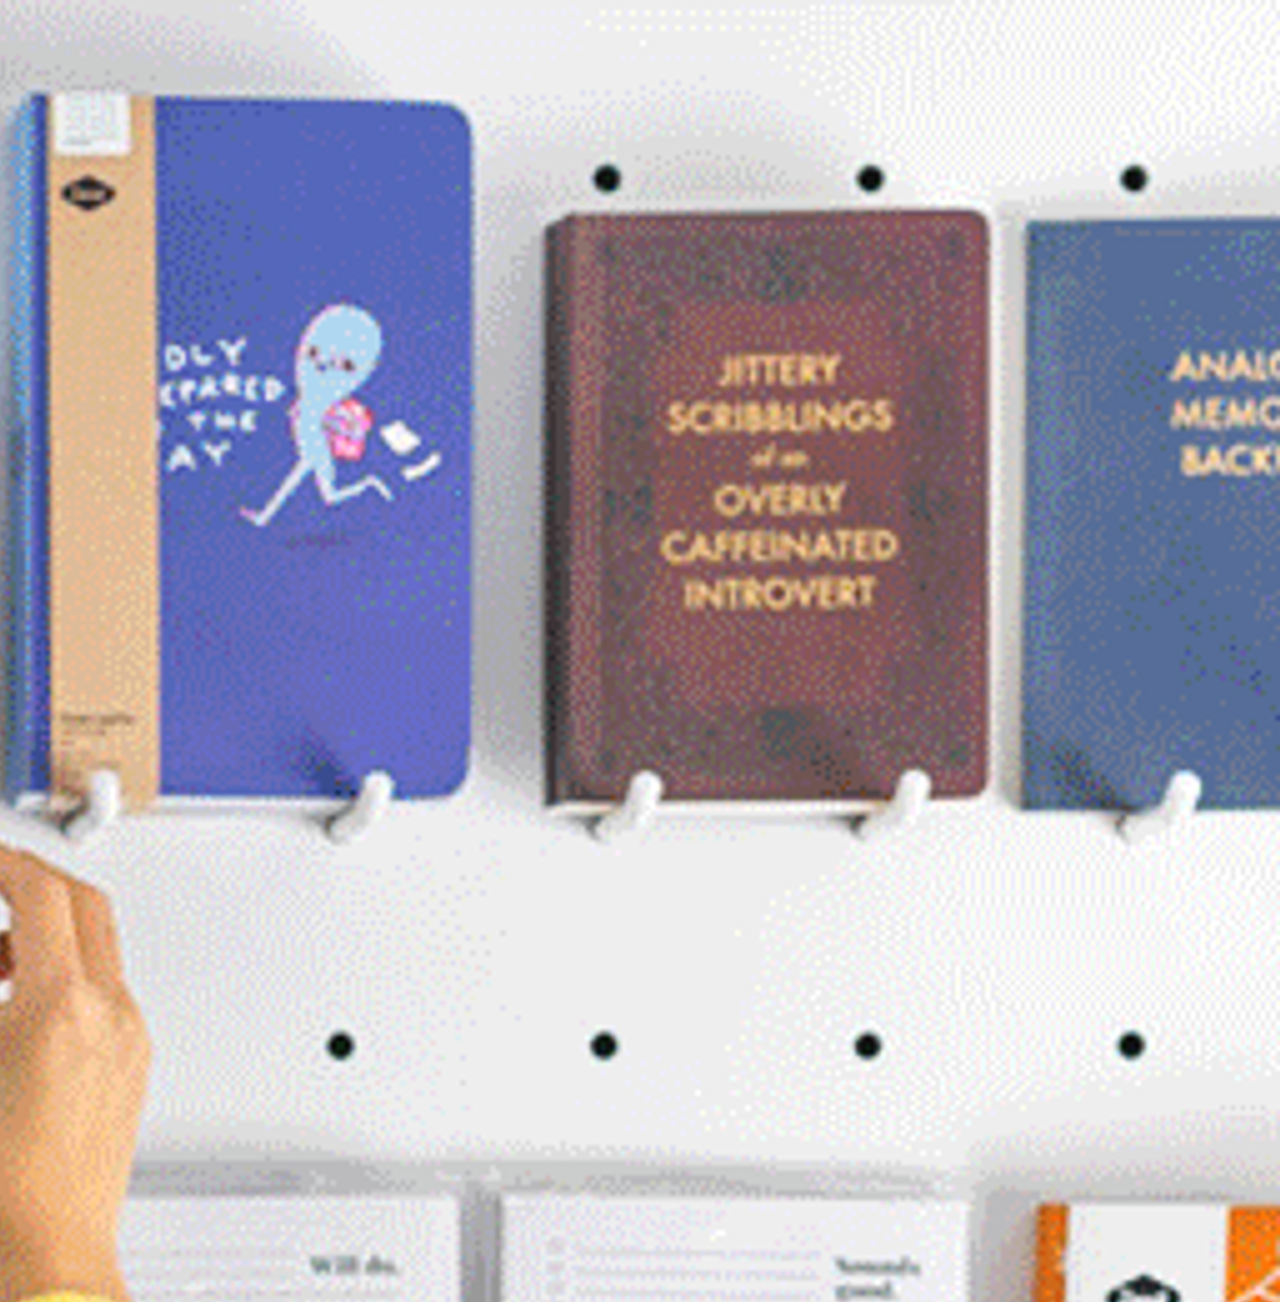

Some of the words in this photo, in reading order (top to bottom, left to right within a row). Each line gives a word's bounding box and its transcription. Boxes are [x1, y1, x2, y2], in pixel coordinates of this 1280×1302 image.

[717, 353, 843, 387] JITTERY
[666, 400, 894, 434] SCRIBBLINGS
[1180, 443, 1280, 476] BACK
[714, 483, 846, 516] OVERLY
[660, 530, 900, 564] CAFFEINATED
[683, 576, 877, 610] INTROVERT
